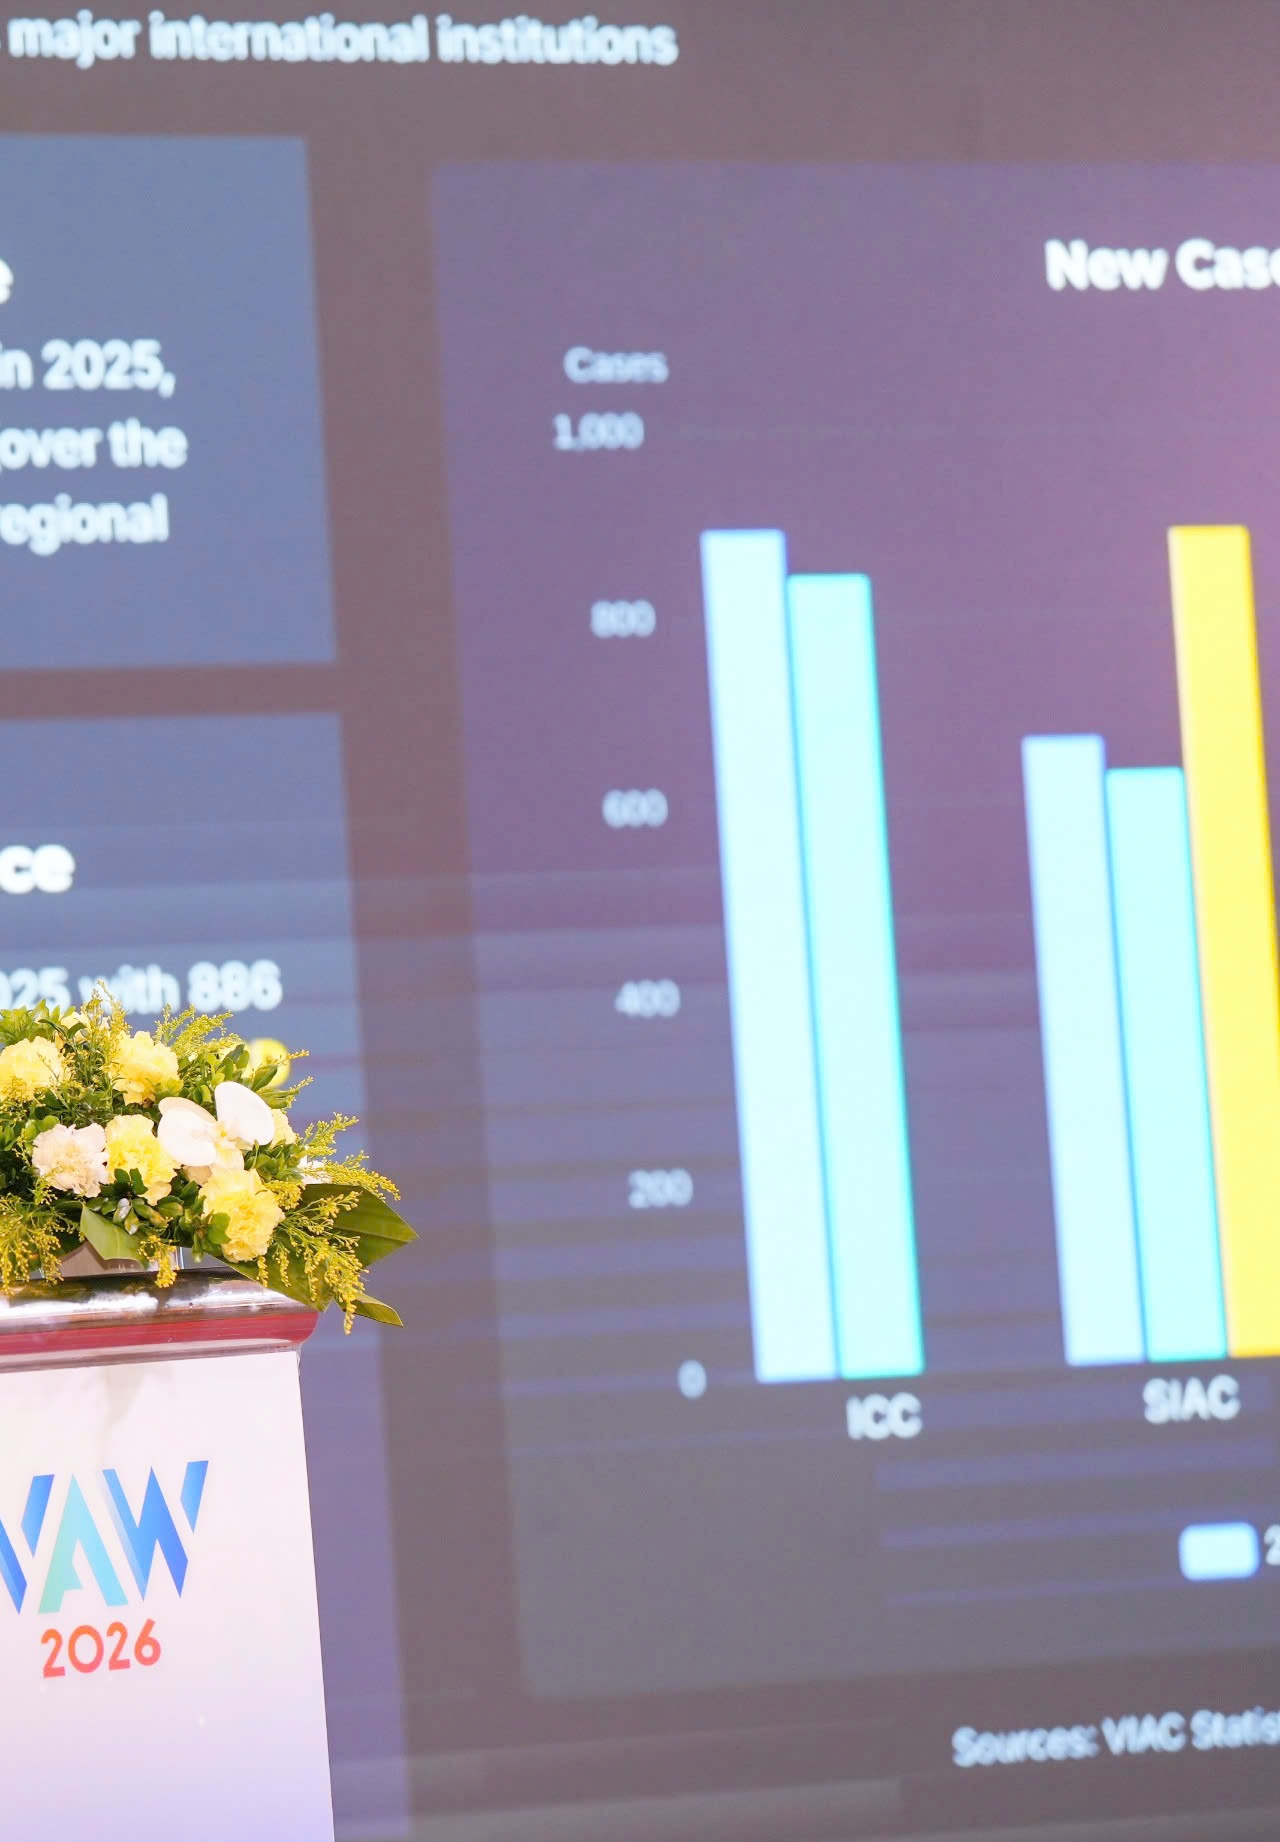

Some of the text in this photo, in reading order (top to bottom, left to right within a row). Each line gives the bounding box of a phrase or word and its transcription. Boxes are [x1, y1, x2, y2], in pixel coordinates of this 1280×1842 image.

[8, 10, 141, 68] major
[149, 11, 429, 63] international
[437, 15, 678, 65] institutions
[1045, 240, 1168, 290] New
[42, 339, 175, 397] 2025,
[564, 347, 668, 383] Cases
[108, 419, 188, 468] the
[592, 601, 656, 637] 800
[603, 789, 668, 827] 600
[78, 964, 180, 1015] with
[188, 960, 282, 1012] 886
[616, 980, 680, 1017] 400
[629, 1170, 693, 1208] 200
[678, 1361, 706, 1397] 0
[1143, 1375, 1240, 1423] SIAC
[847, 1393, 922, 1439] ICC
[40, 1619, 161, 1677] 2026
[952, 1726, 1097, 1767] Sources:
[1102, 1712, 1185, 1754] VIAC
